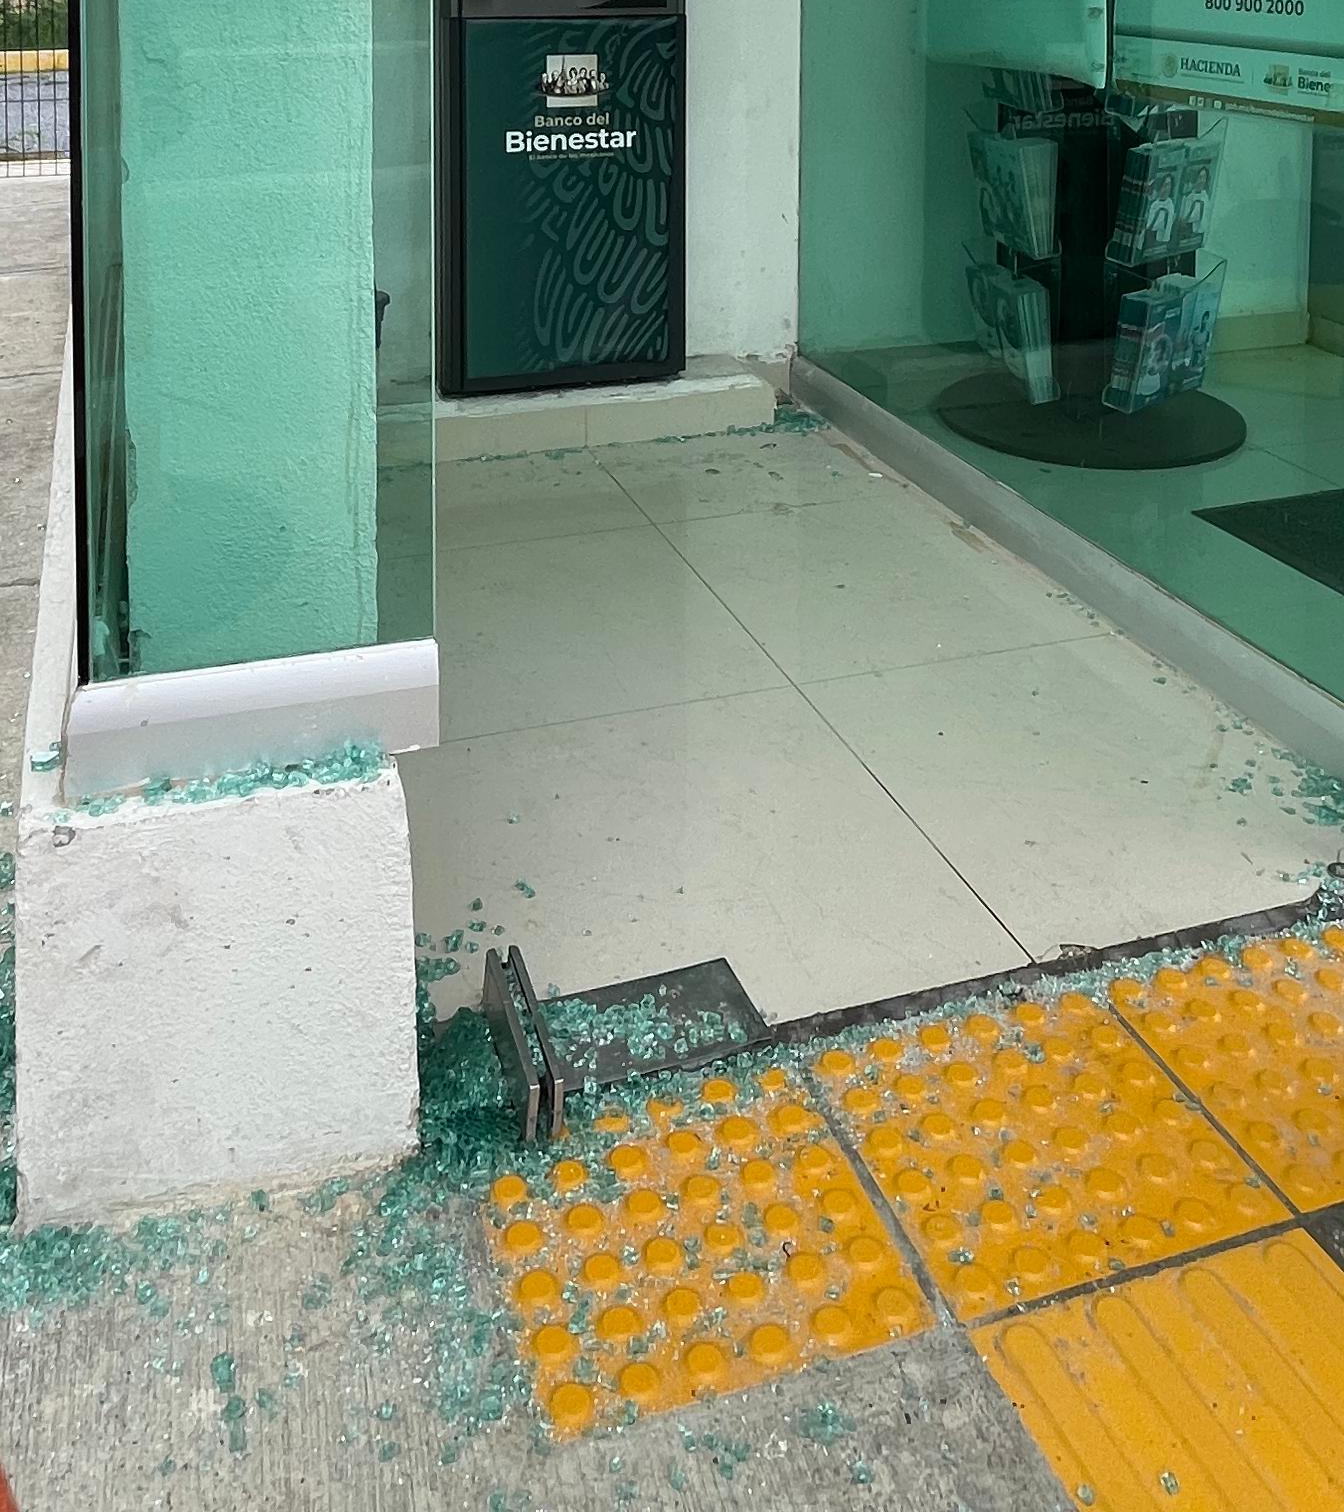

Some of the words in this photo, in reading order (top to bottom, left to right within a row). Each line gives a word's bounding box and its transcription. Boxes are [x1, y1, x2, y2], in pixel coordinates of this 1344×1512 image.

[1180, 56, 1241, 77] HACIENDA
[1297, 76, 1330, 92] Biene
[534, 115, 582, 127] Banco
[586, 112, 610, 126] del
[505, 129, 637, 153] Bienestar
